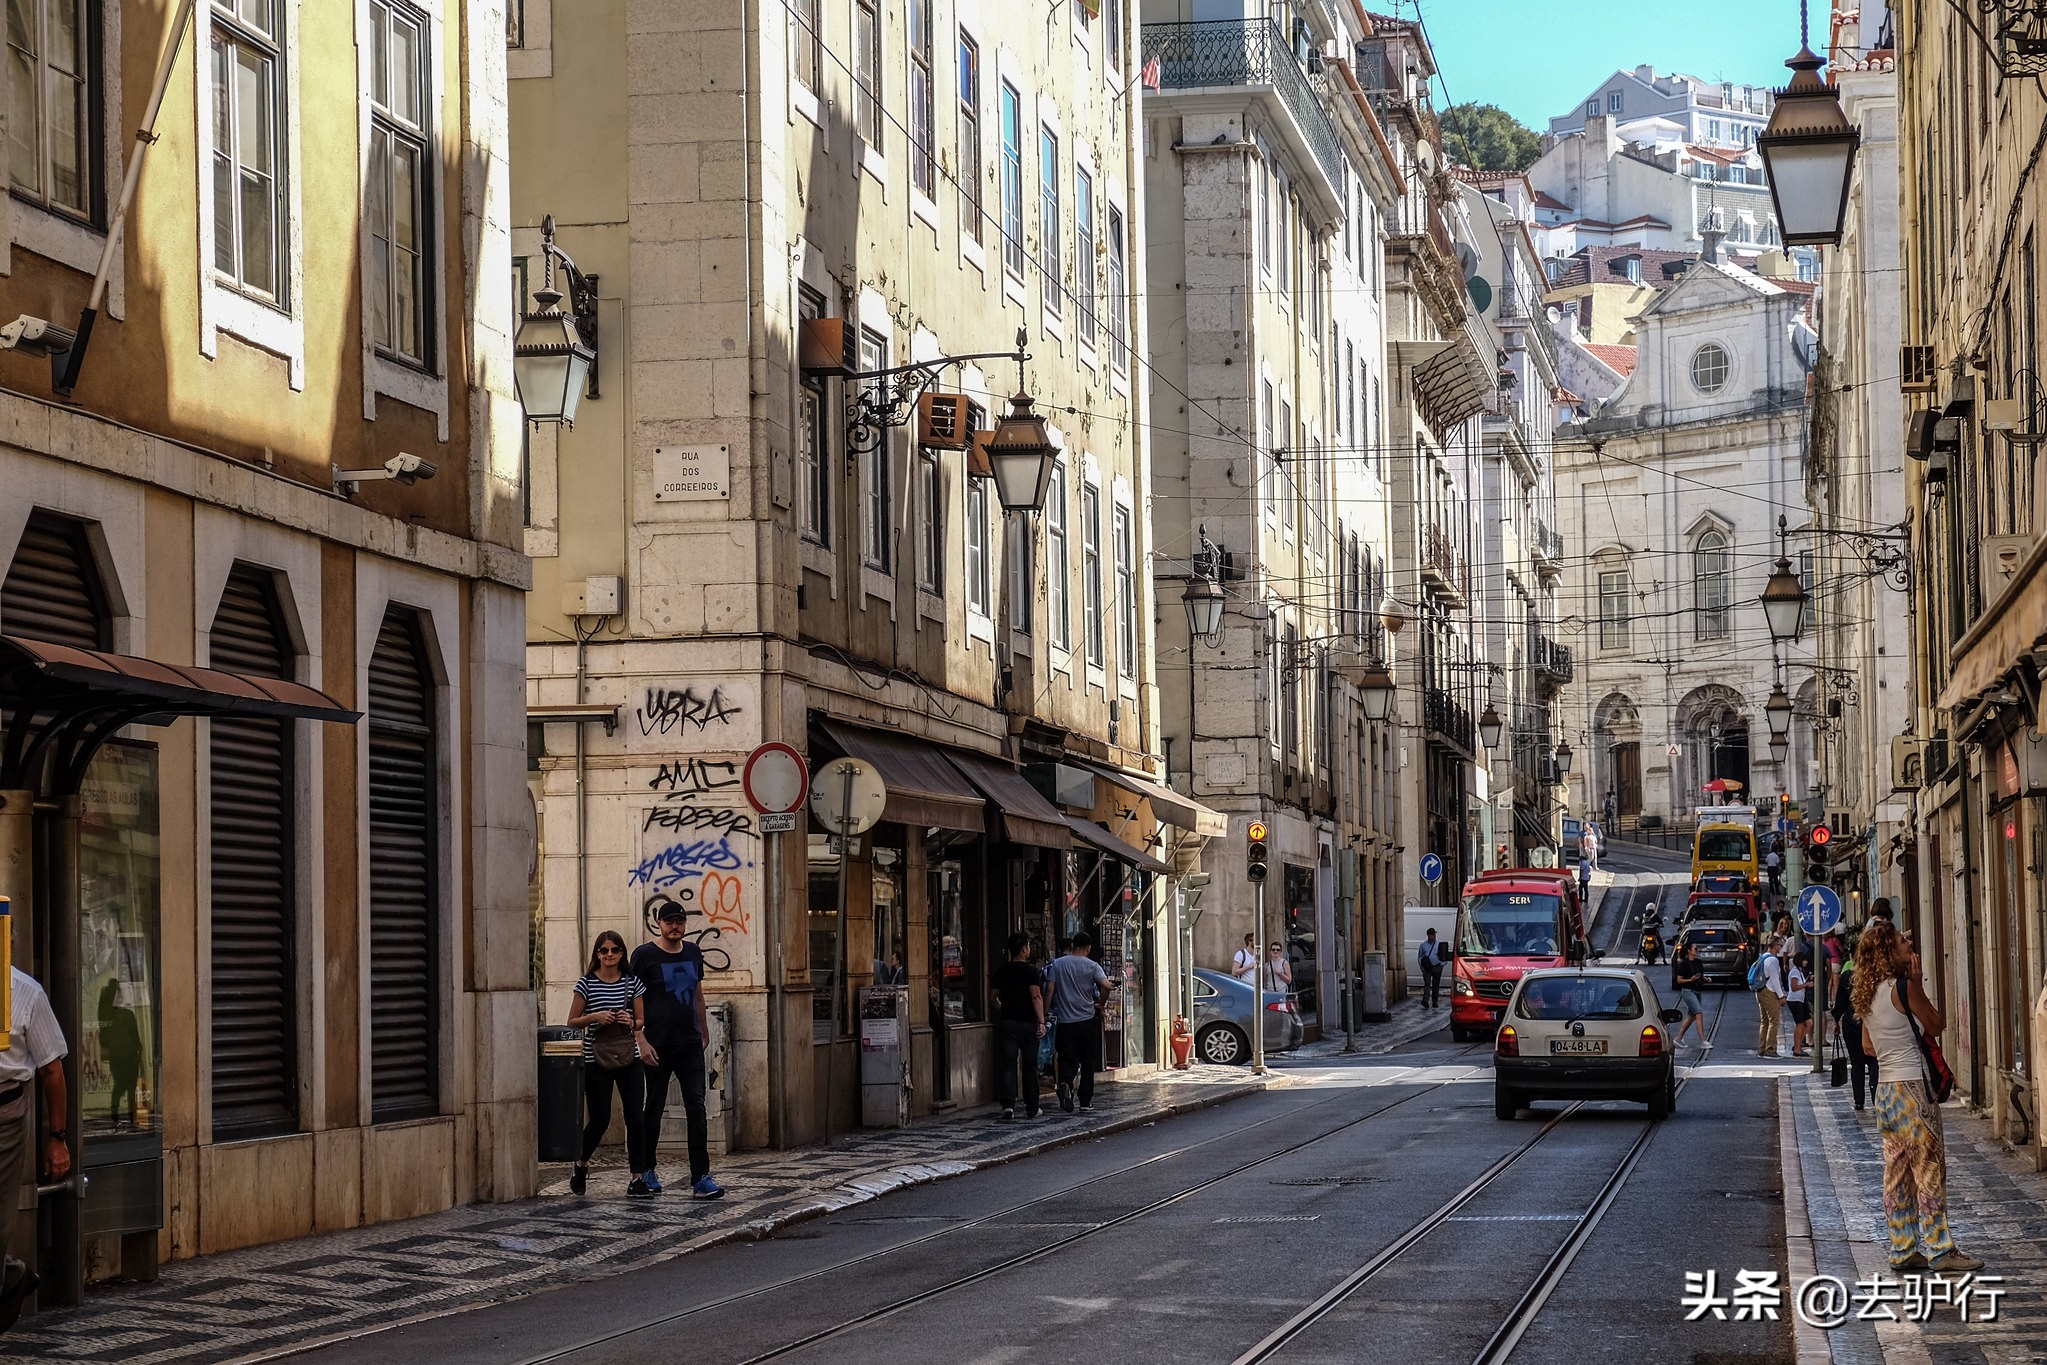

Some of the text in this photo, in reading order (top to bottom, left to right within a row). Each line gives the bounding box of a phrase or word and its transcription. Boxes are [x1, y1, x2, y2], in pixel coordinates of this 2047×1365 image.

[681, 452, 700, 461] RUA
[682, 467, 700, 476] DOS
[664, 482, 719, 492] CORREEIROS
[80, 788, 108, 804] GRESSO
